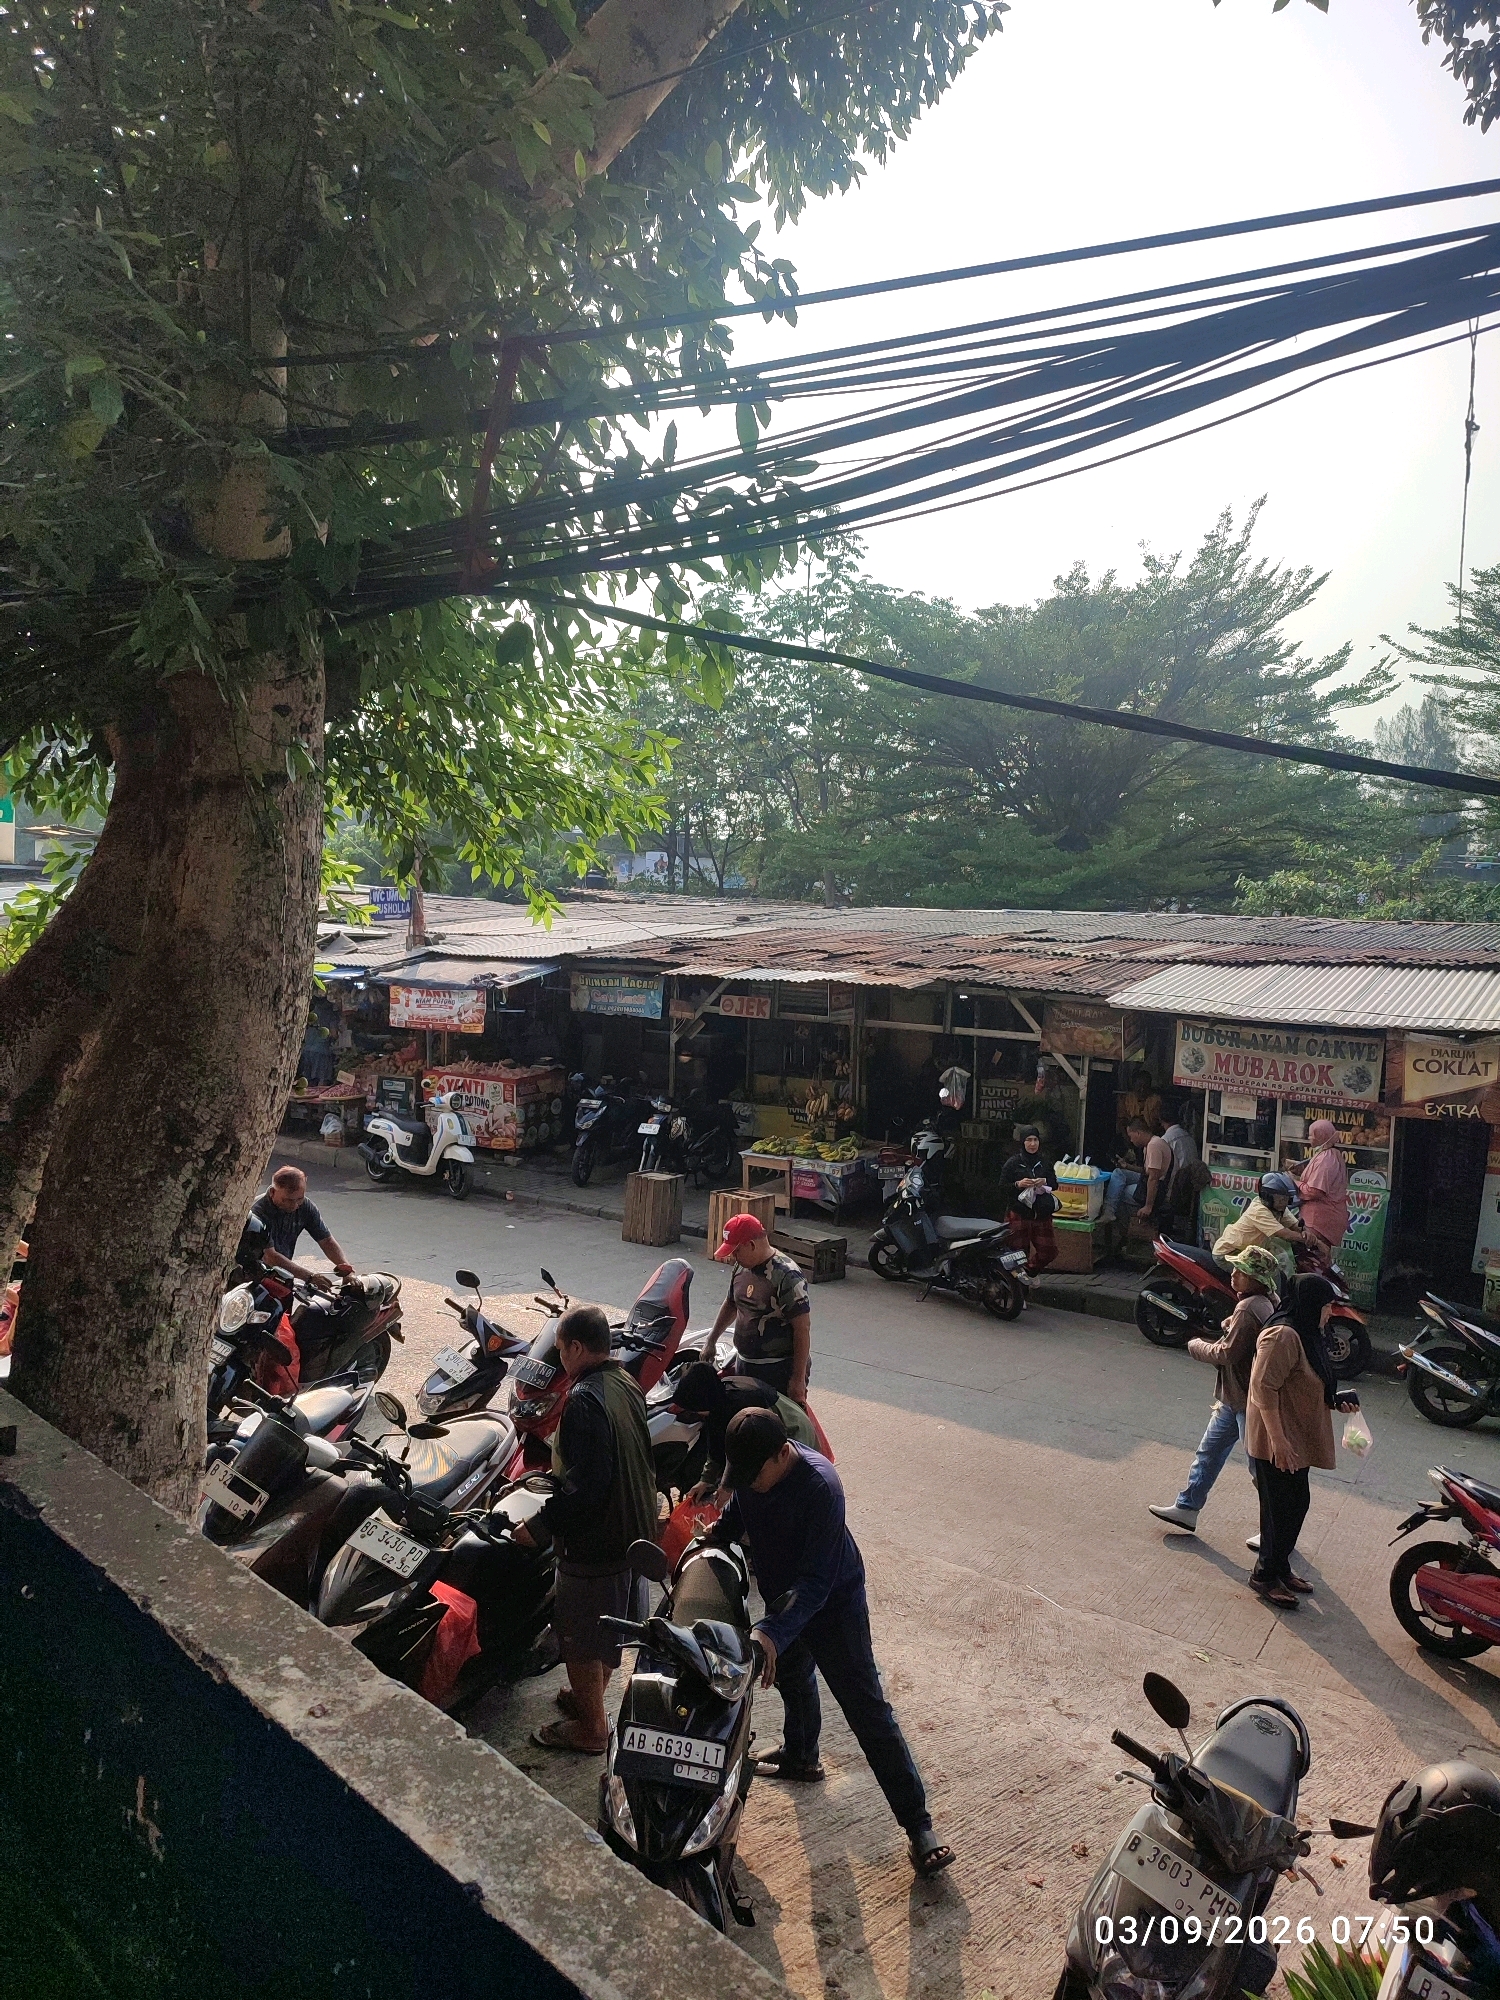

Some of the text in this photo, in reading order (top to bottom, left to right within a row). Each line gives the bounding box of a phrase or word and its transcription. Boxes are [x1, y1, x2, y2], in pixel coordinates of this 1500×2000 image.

[372, 890, 386, 902] WC
[371, 902, 411, 914] USHOLLA
[722, 998, 769, 1017] OJEK
[1180, 1022, 1379, 1062] BUBUR AYAM CAKWE
[1430, 1048, 1476, 1060] DJARUM
[1213, 1052, 1335, 1088] MUBAROK
[1412, 1058, 1493, 1077] COKLAT
[445, 1078, 485, 1095] YANTI
[981, 1086, 1018, 1097] TUTUP
[1180, 1078, 1225, 1092] MENERIMA
[1227, 1085, 1271, 1098] PESANAN
[1201, 1074, 1236, 1084] CABANG
[1239, 1079, 1268, 1088] DEPAN
[1289, 1085, 1344, 1097] CIJANTUNG
[1305, 1107, 1365, 1127] BUBUR AYAM
[1424, 1102, 1481, 1118] EXTRA
[1211, 1172, 1261, 1194] BUBU
[1354, 1177, 1381, 1186] BUKA
[209, 1463, 220, 1476] B
[218, 1470, 234, 1486] 32
[626, 1731, 722, 1765] AB 6639 LT
[1127, 1834, 1238, 1918] B 3603 PMR
